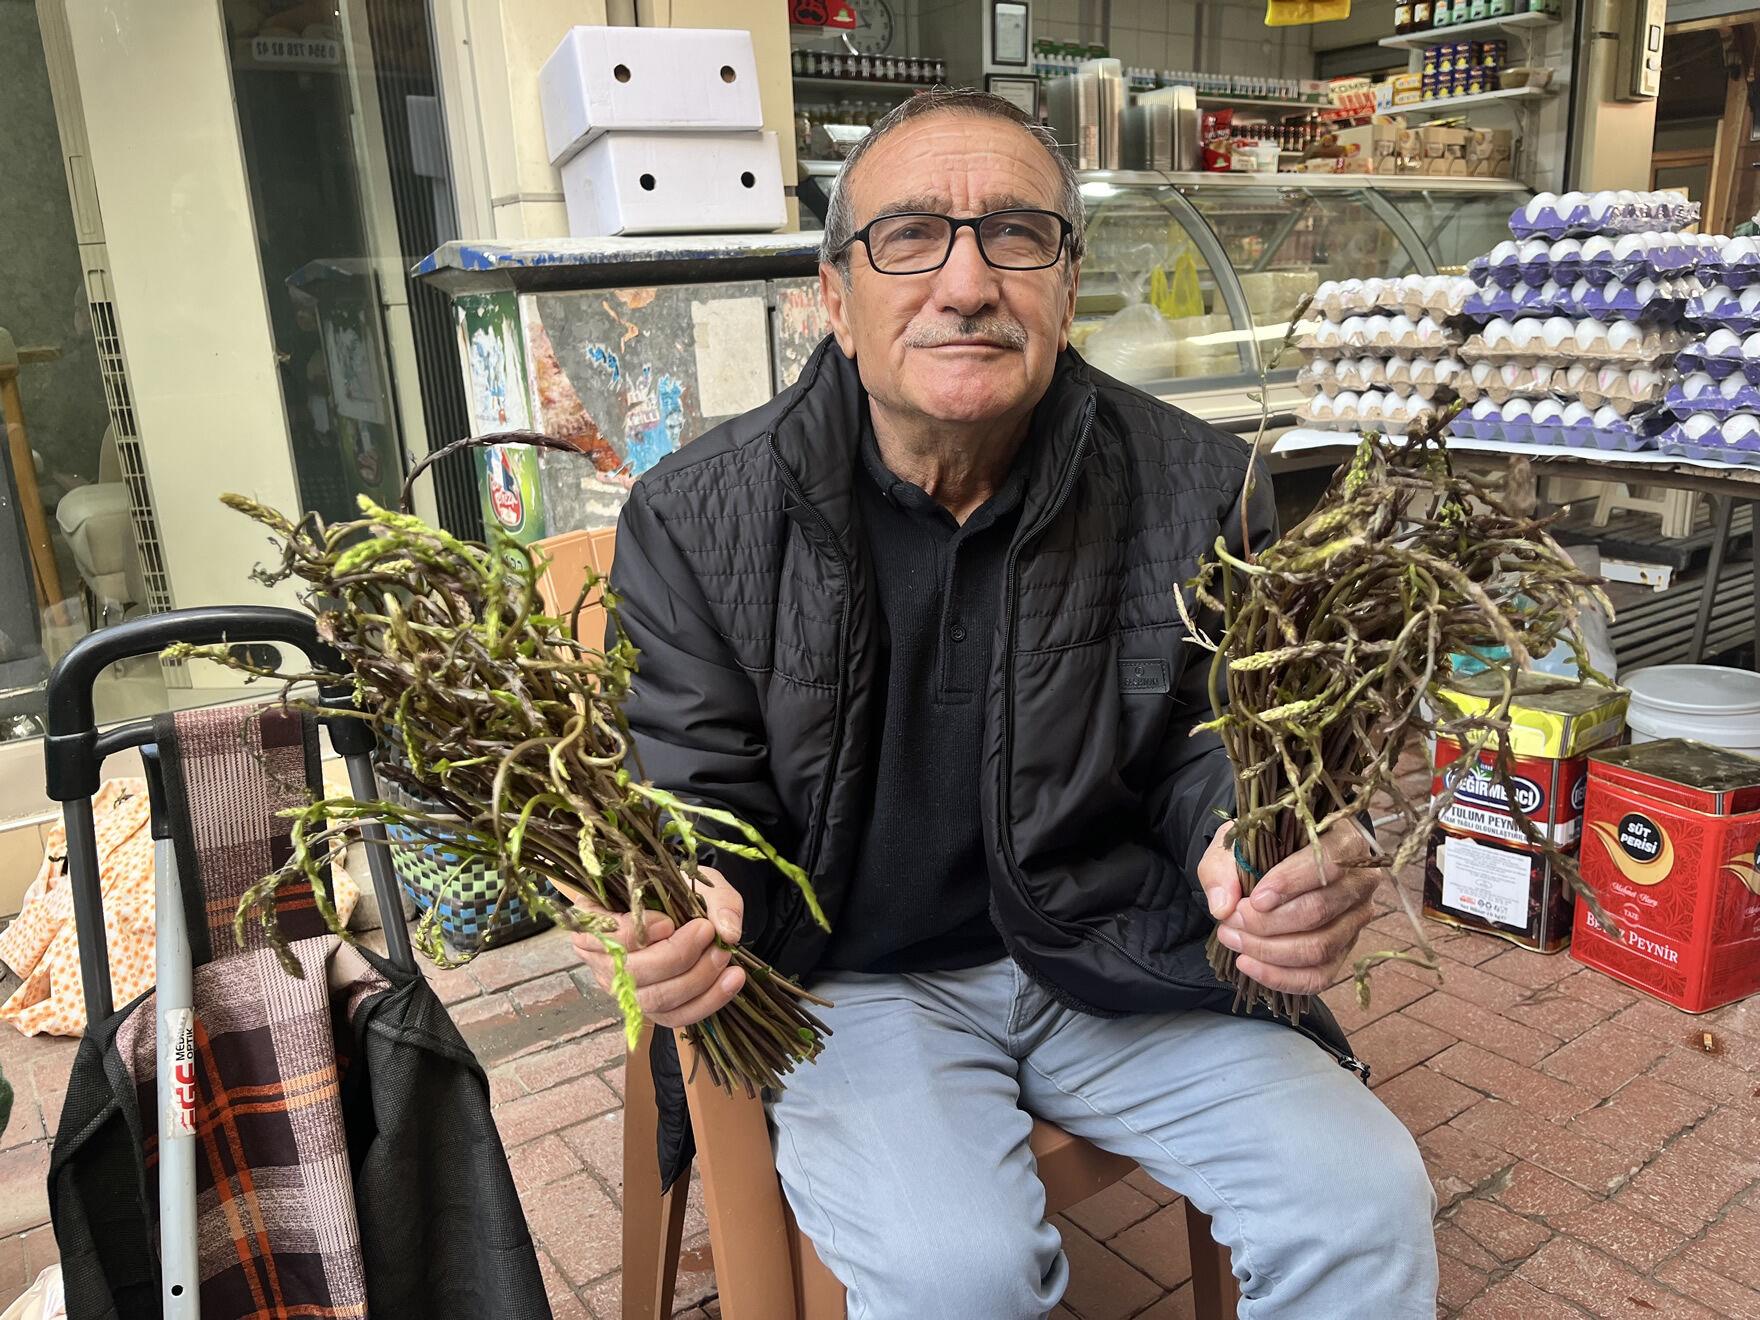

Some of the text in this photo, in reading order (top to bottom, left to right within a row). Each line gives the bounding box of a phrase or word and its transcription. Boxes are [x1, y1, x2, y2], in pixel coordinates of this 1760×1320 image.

[1451, 806, 1485, 823] TULUM
[1627, 822, 1651, 838] SÜT
[1620, 833, 1658, 854] PERİSİ
[1628, 930, 1679, 963] PEYNİR
